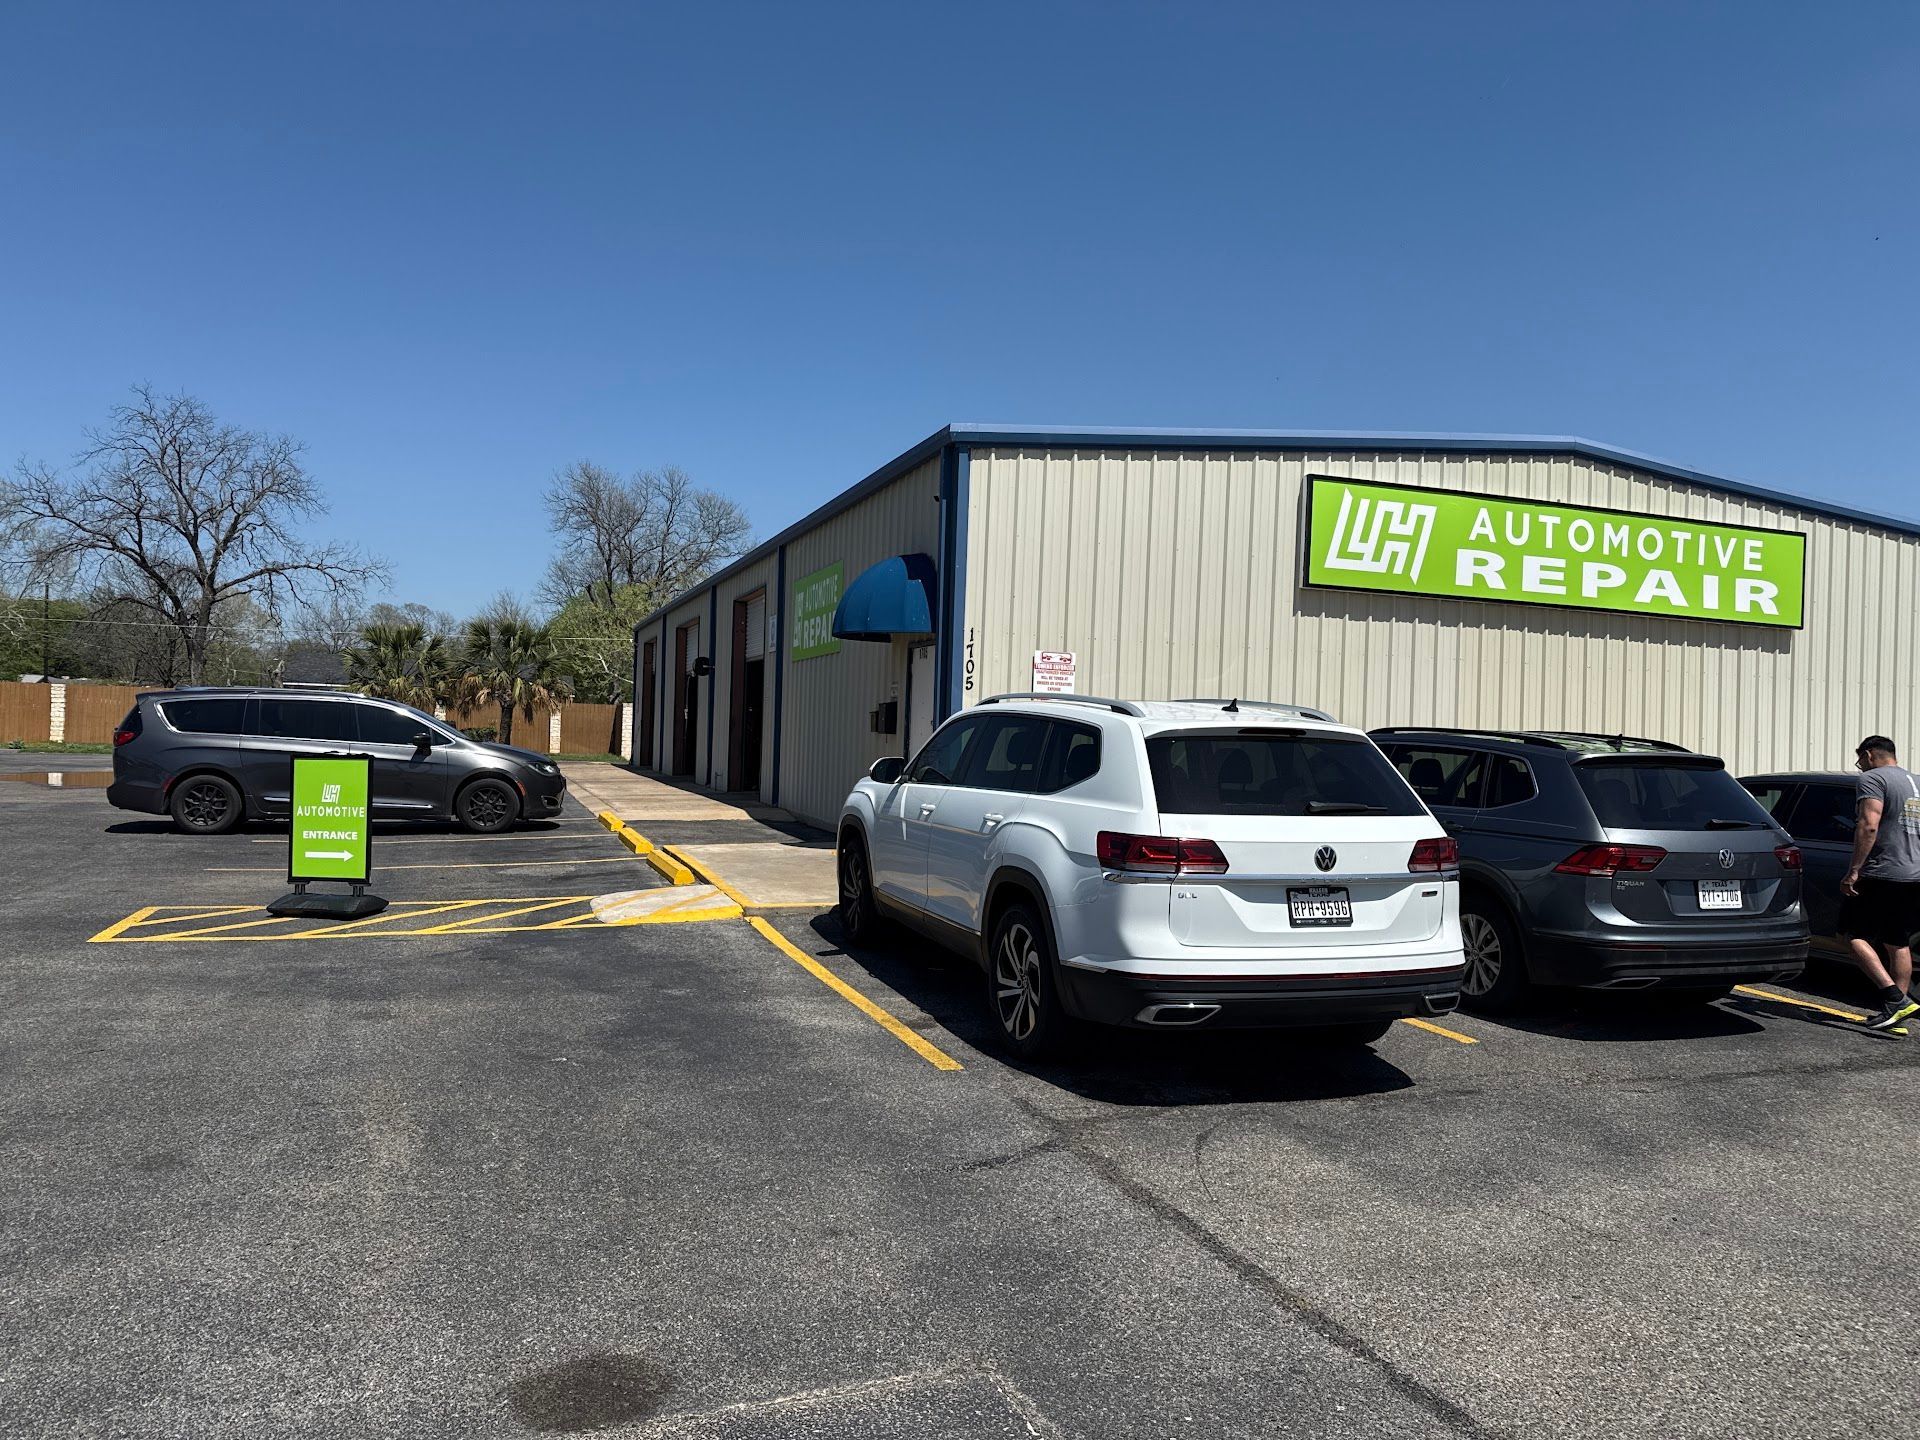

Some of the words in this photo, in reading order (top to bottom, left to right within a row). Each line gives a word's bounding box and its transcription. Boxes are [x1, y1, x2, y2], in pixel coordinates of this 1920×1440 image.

[1468, 507, 1765, 572] AUTOMOTIVE
[805, 574, 838, 612] AUTOMOTIVE
[1455, 549, 1780, 616] REPAIR
[965, 627, 975, 690] 1705
[296, 805, 365, 818] AUTOMOTIVE
[302, 830, 358, 840] ENTRANCE
